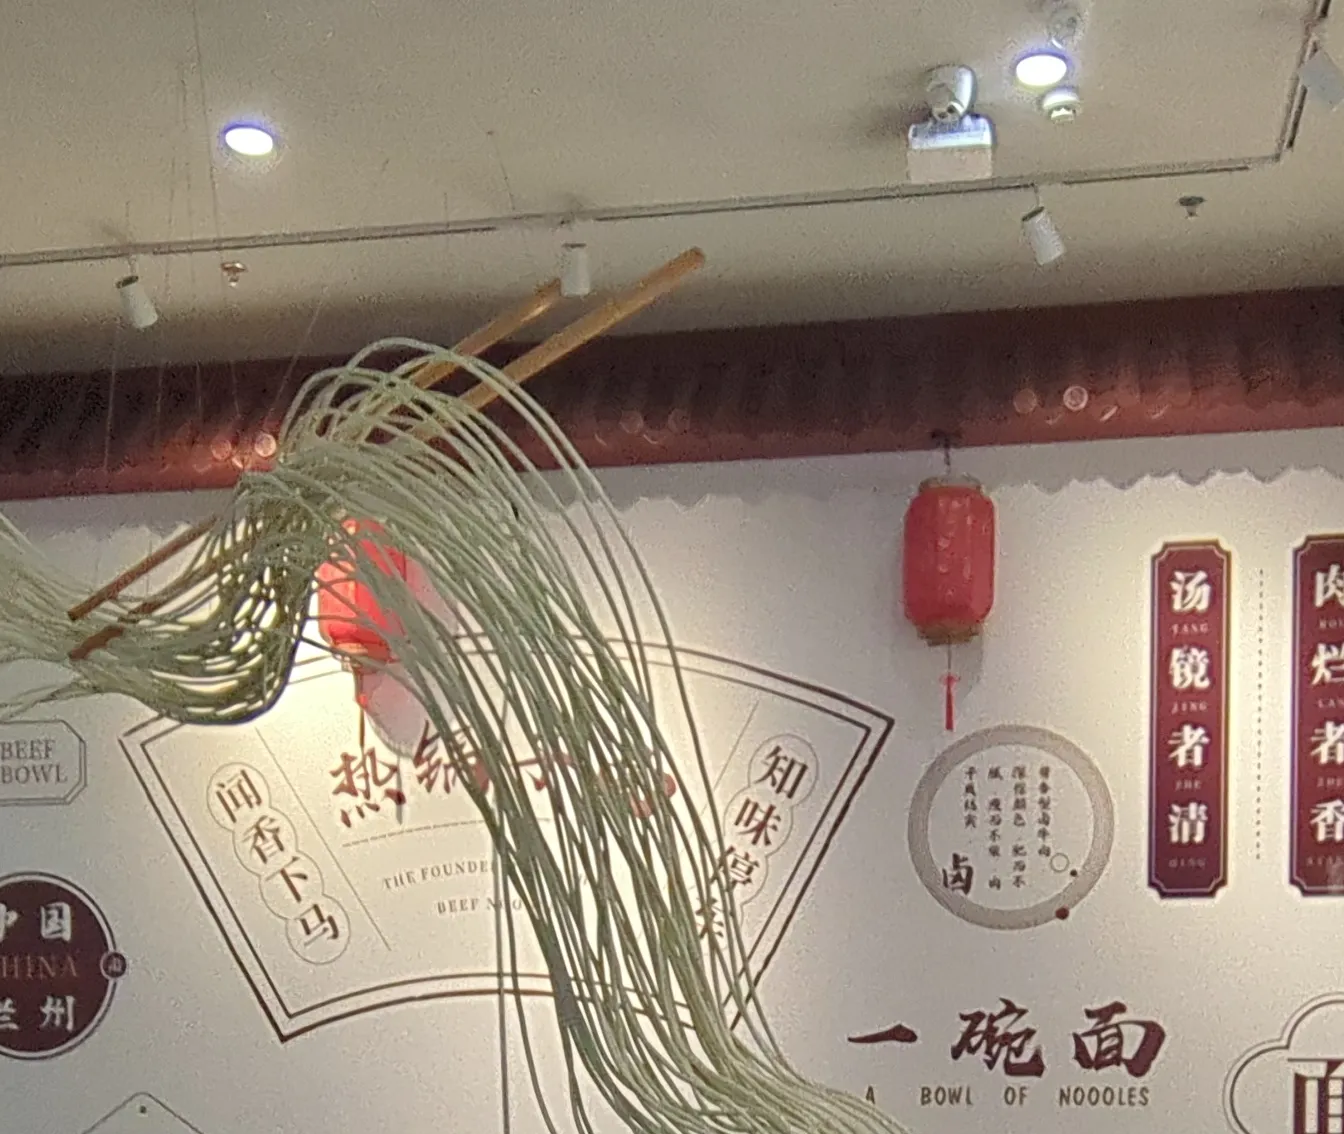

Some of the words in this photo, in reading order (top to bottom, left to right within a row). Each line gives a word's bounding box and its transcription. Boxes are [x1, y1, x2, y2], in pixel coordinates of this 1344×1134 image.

[1167, 569, 1211, 844] 汤镜者清
[0, 739, 55, 760] BEEF
[0, 763, 68, 785] BOWL
[214, 769, 341, 949] 闻香下马
[420, 857, 499, 883] FOUNDE
[942, 852, 974, 896] 卤
[846, 998, 1168, 1078] 一碗面
[864, 1087, 876, 1106] A
[920, 1086, 975, 1107] BOWL
[1004, 1087, 1029, 1106] OF
